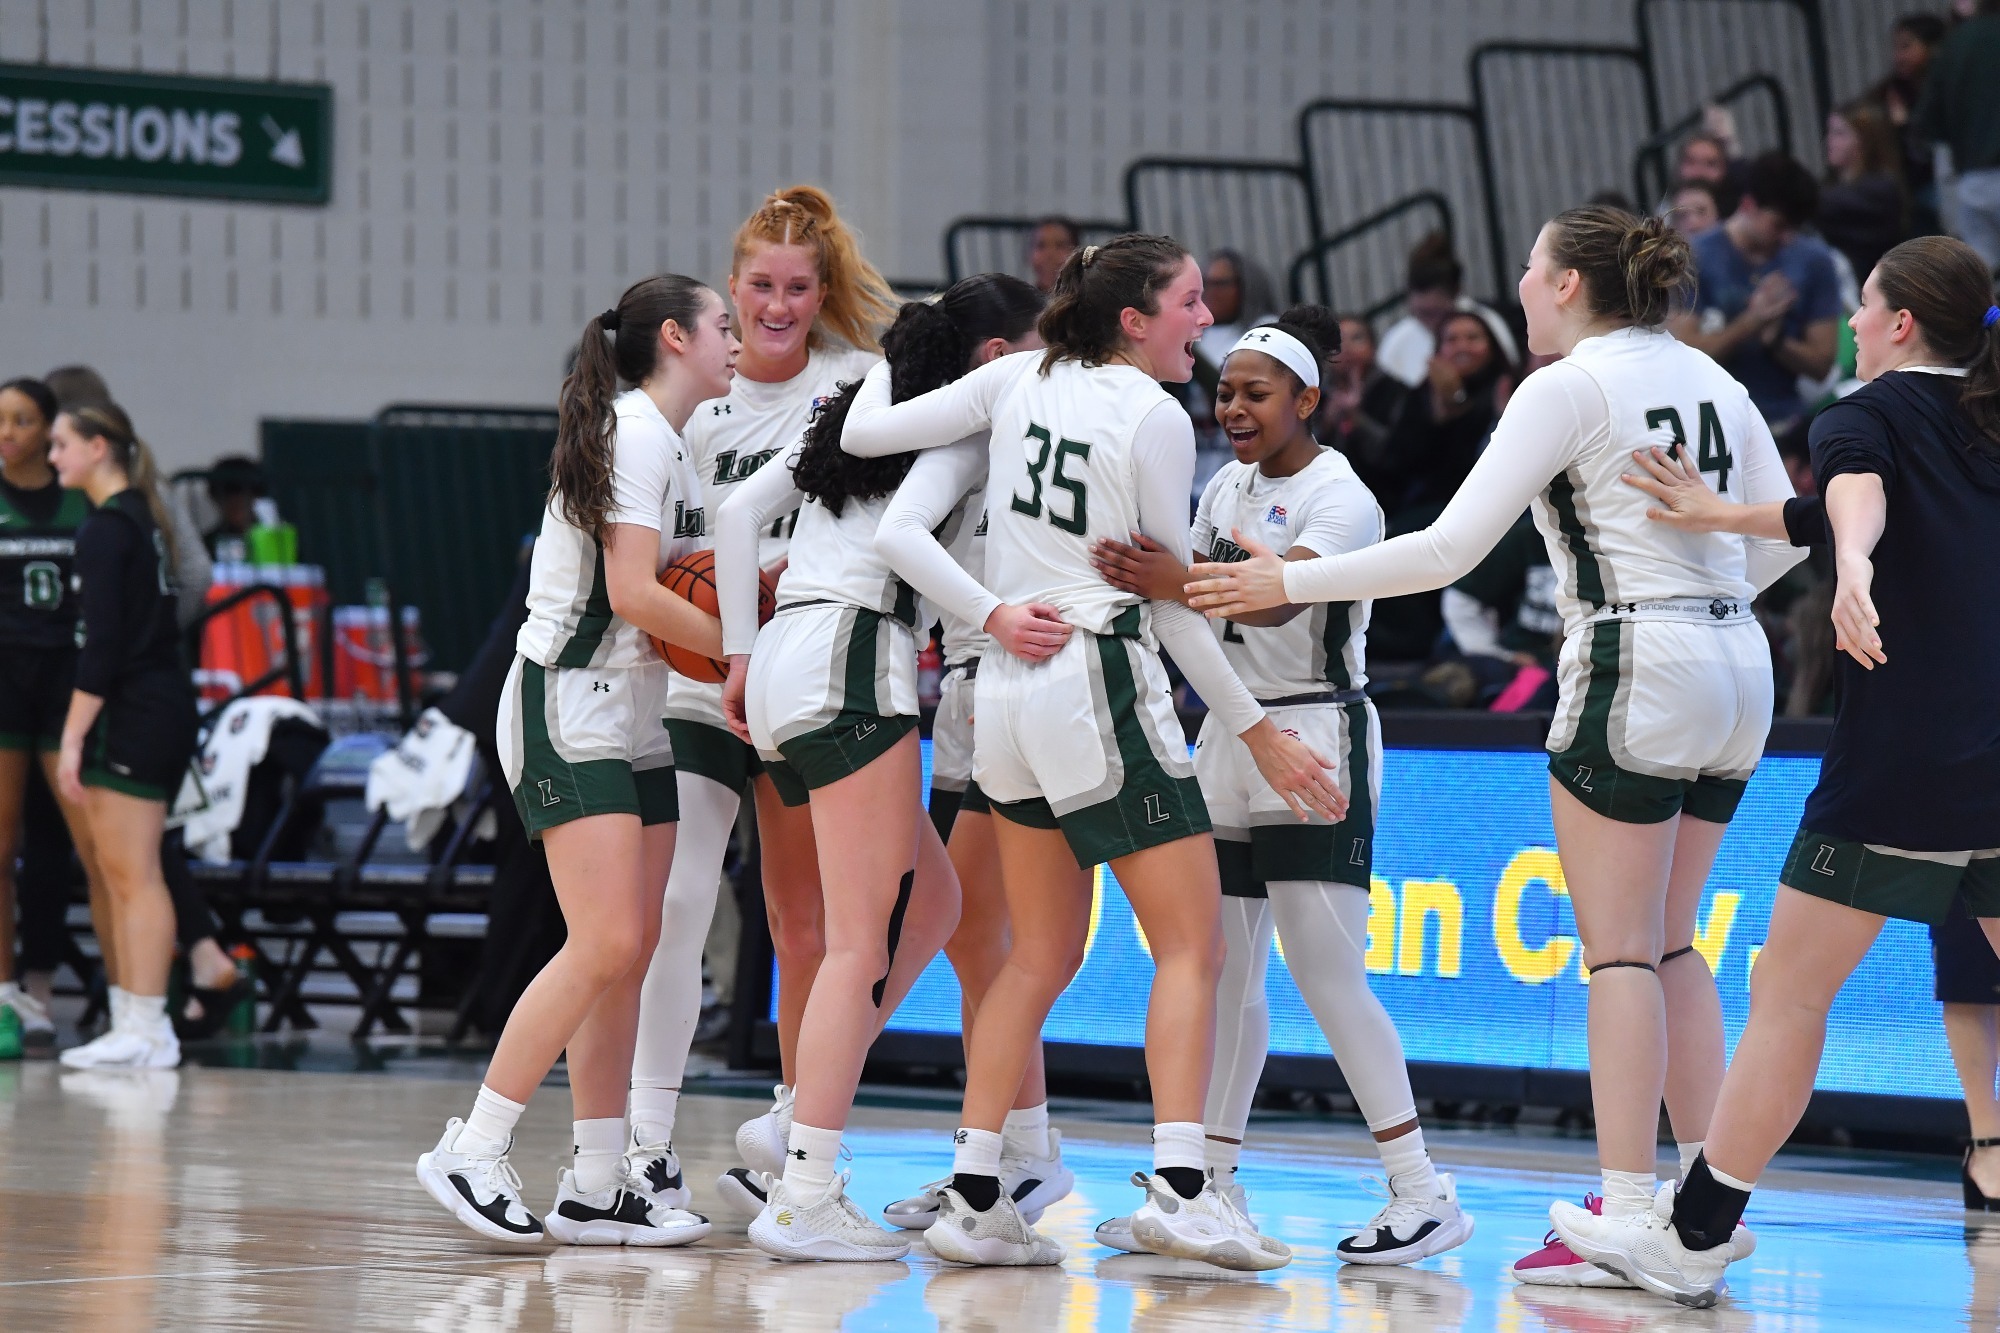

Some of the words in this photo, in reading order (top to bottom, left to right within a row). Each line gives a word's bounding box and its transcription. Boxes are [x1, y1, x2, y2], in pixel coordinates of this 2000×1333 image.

[1010, 420, 1093, 538] 35
[1640, 603, 1680, 613] ARMOUR
[1683, 604, 1707, 613] UNDER
[538, 779, 560, 807] L
[1144, 794, 1170, 825] L
[1349, 838, 1364, 866] L
[1811, 844, 1835, 876] L
